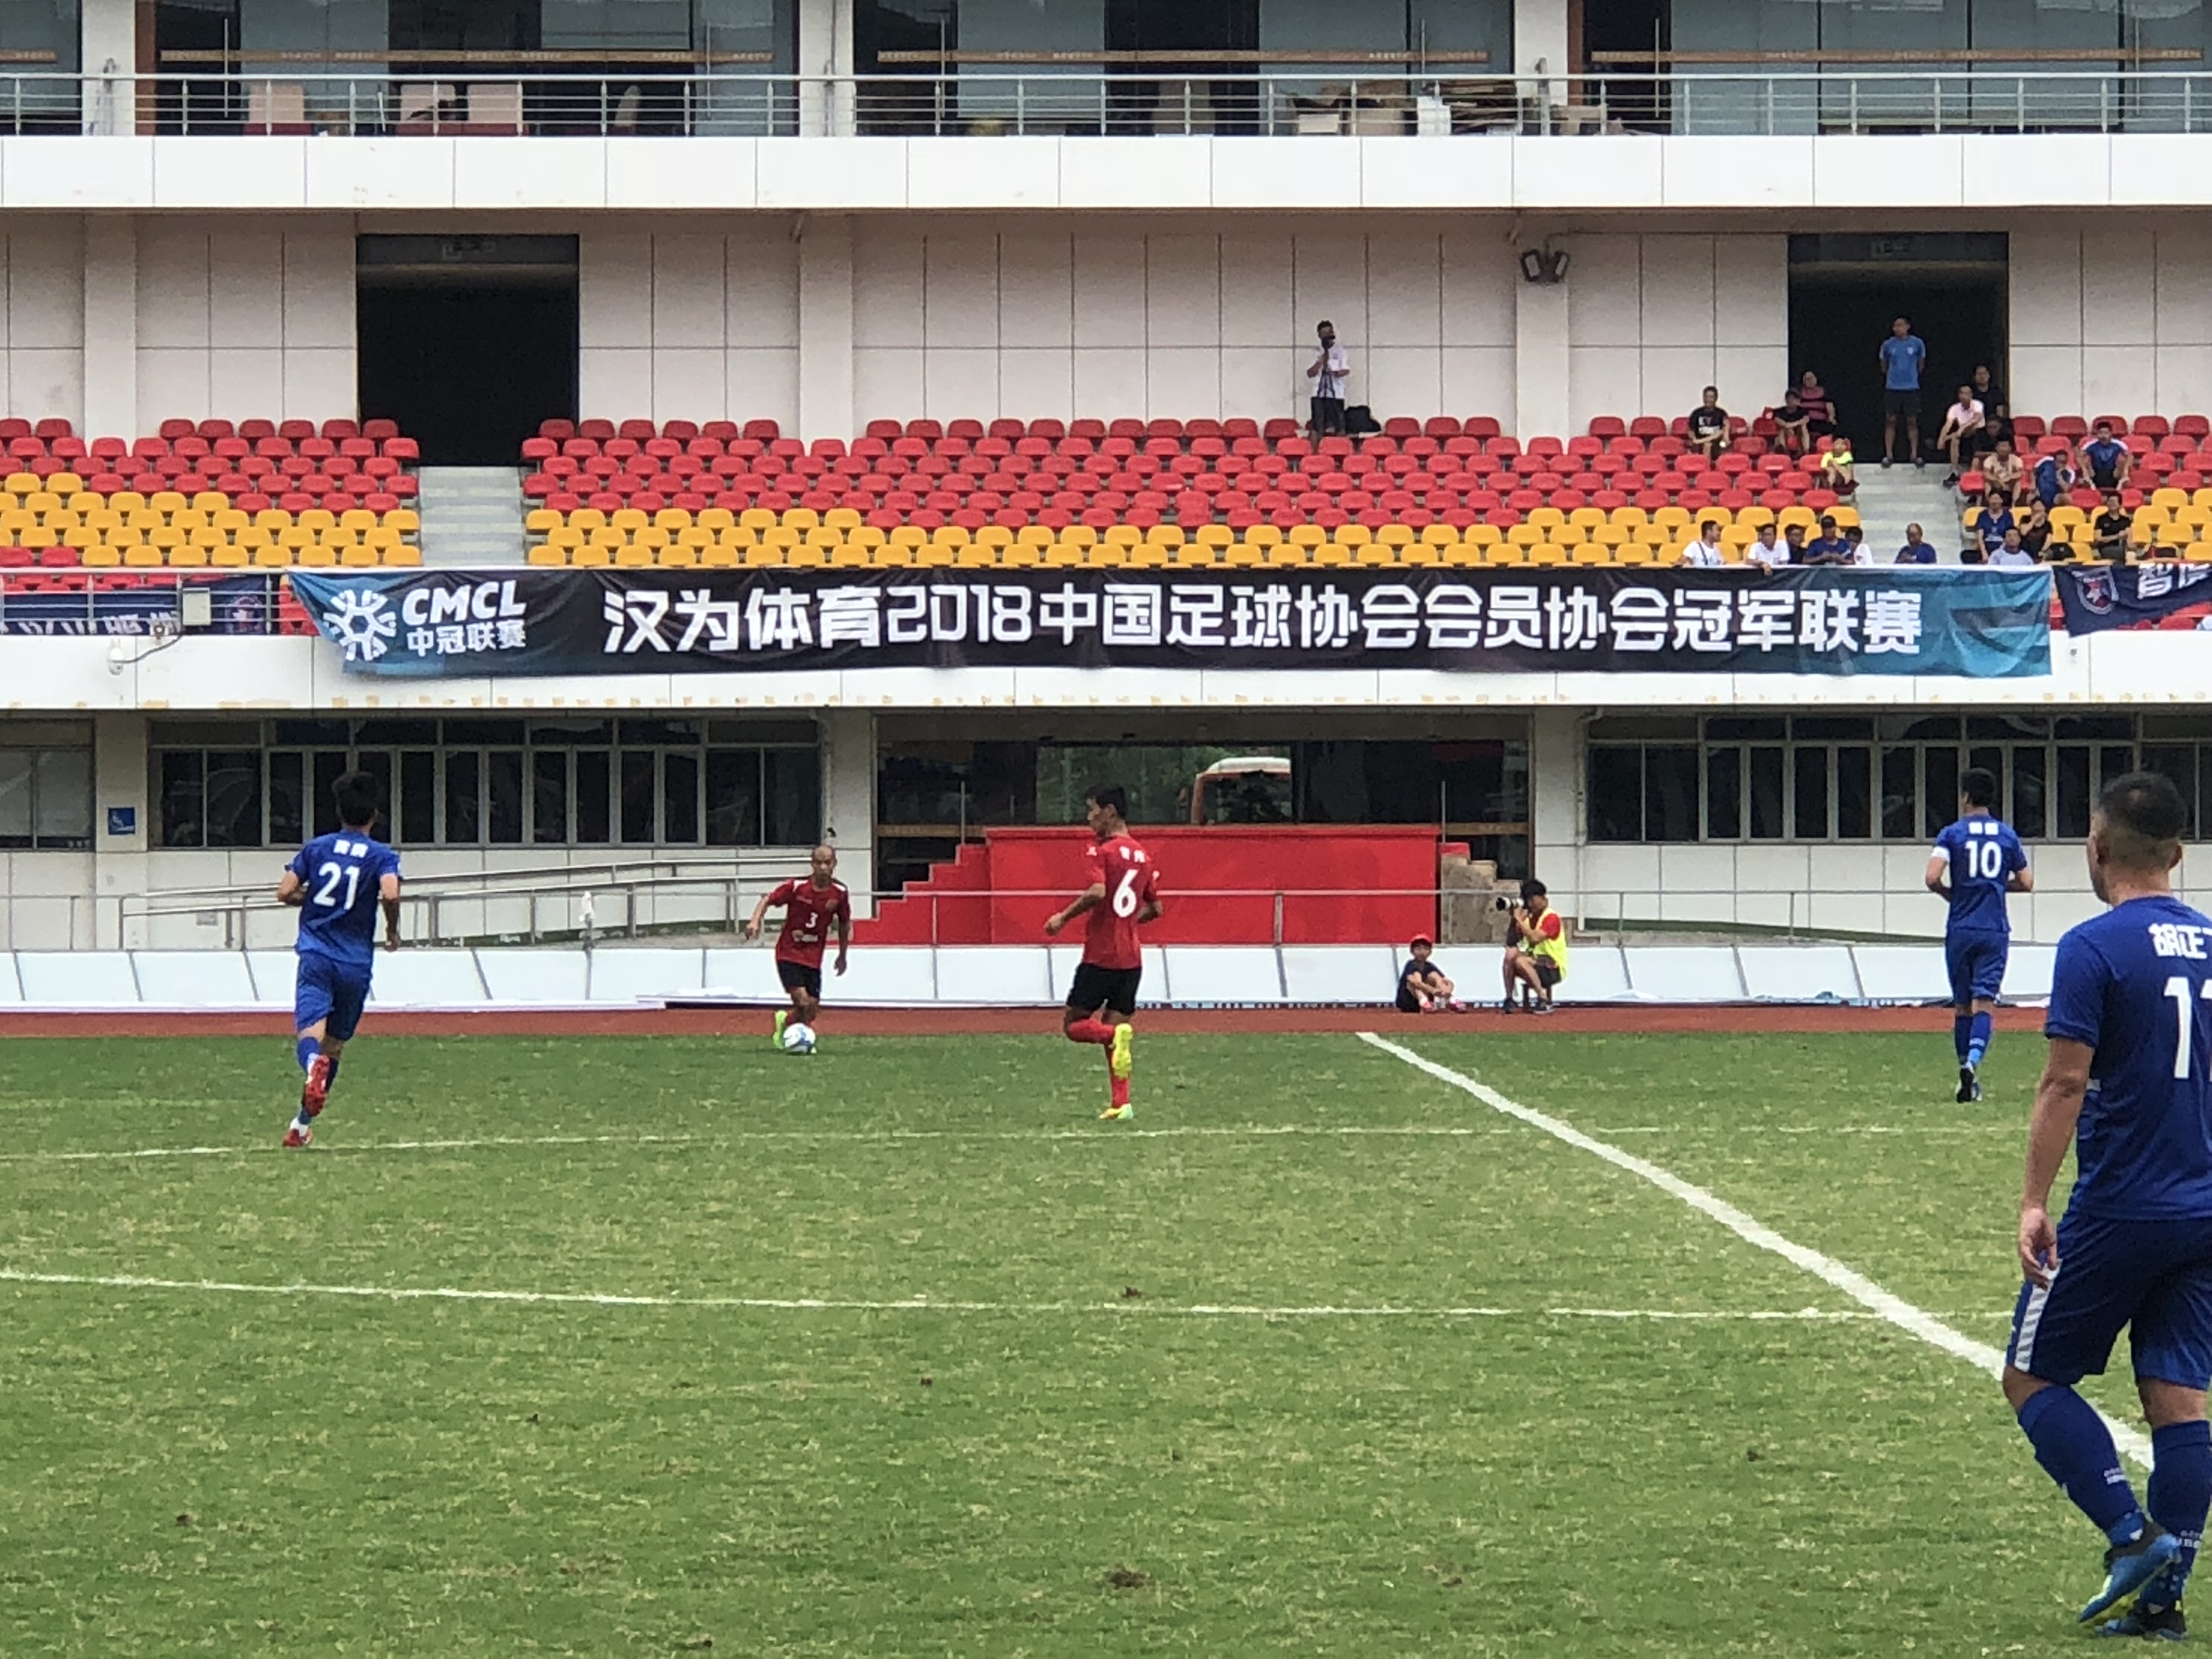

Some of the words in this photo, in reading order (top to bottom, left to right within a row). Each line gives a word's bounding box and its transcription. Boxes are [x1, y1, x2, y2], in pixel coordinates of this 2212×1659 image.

[402, 580, 526, 625] CMCL
[603, 582, 1922, 653] 汉为体育2018中国足球协会会员协会冠军联赛
[407, 619, 526, 656] 中冠联赛
[1965, 840, 2002, 878] 10
[313, 862, 360, 910] 21
[1113, 869, 1138, 917] 6
[805, 912, 818, 928] 3
